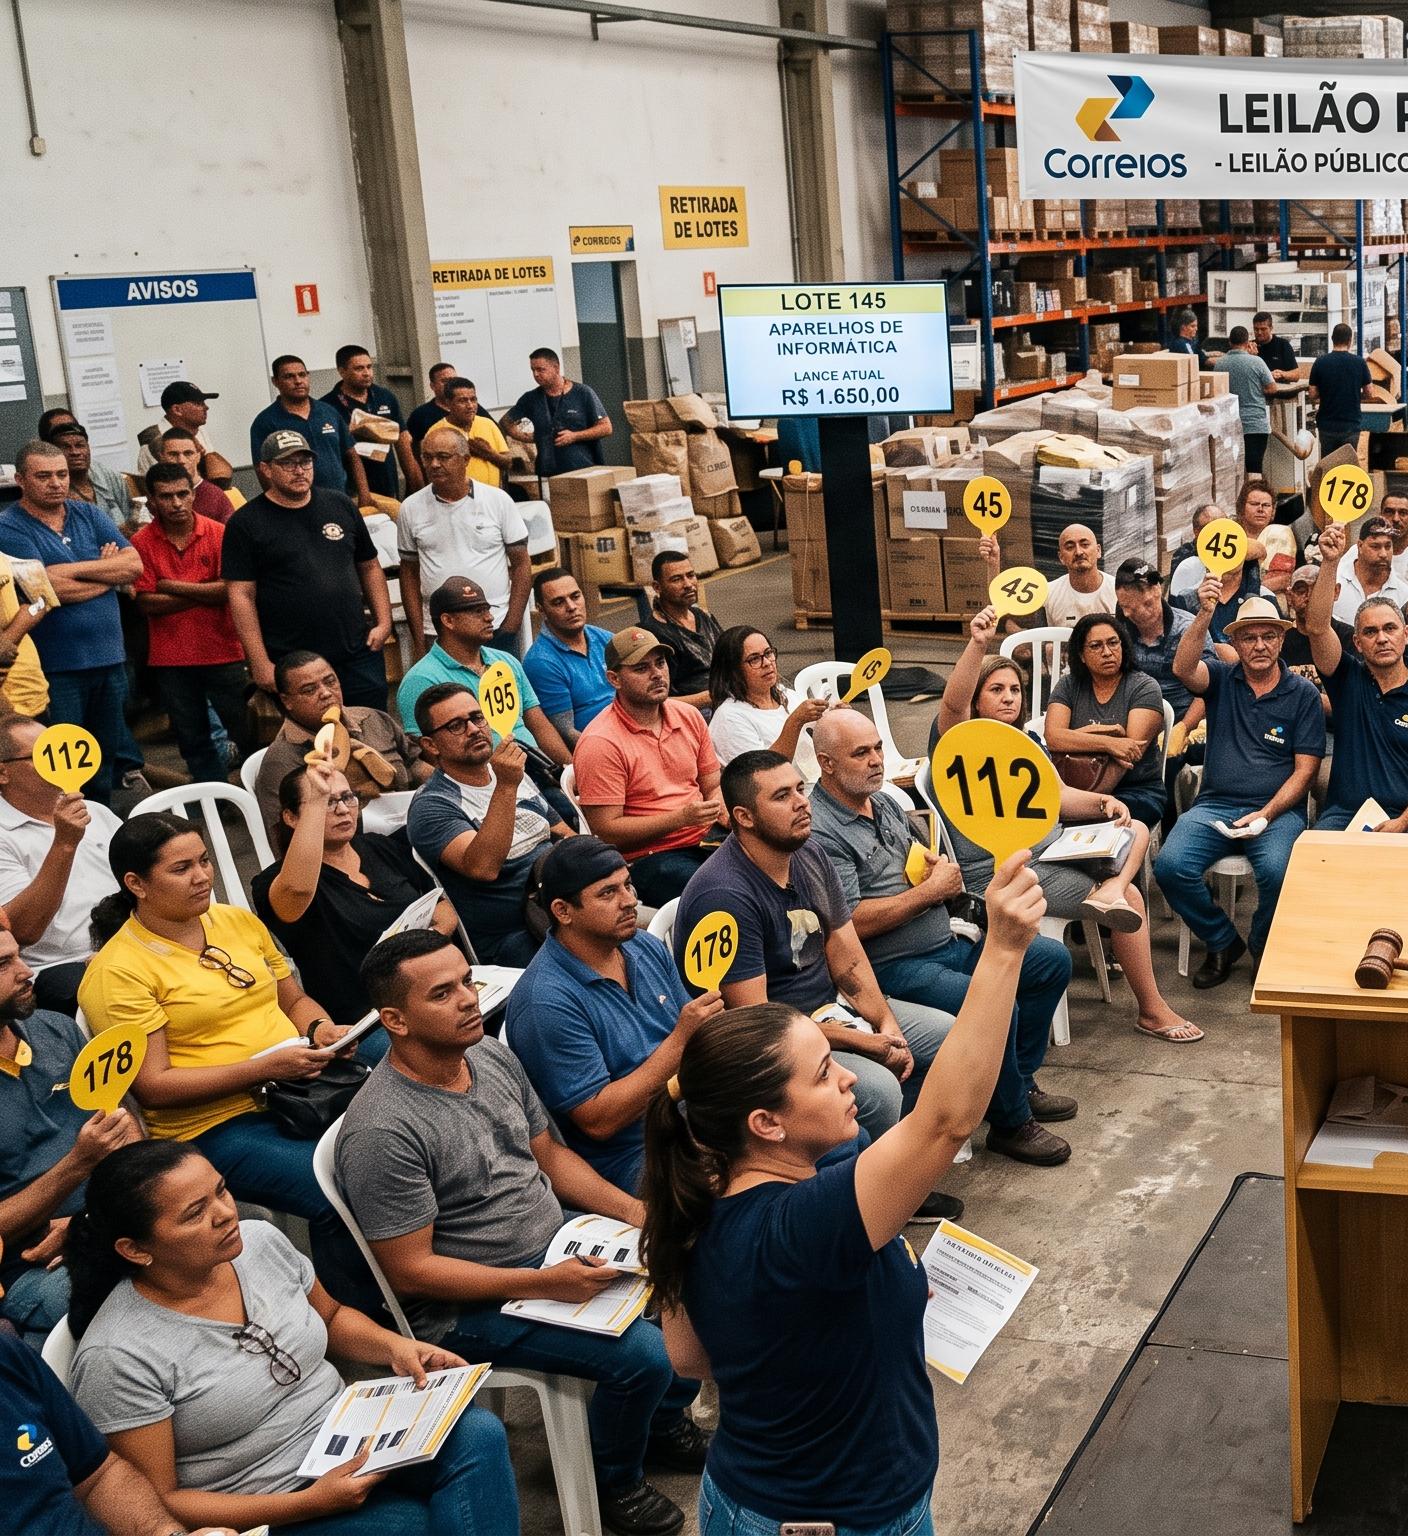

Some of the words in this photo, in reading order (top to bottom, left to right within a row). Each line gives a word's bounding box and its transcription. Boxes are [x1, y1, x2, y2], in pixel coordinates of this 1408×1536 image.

[1218, 81, 1380, 134] LEILÃO
[1044, 148, 1188, 179] Correios
[1228, 148, 1308, 173] LEILÃO
[670, 196, 738, 214] RETIRADA
[674, 221, 692, 238] DE
[696, 220, 738, 238] LOTES
[432, 269, 491, 283] RETIRADA
[495, 268, 509, 280] DE
[512, 266, 546, 279] LOTES
[127, 279, 199, 300] AVISOS
[781, 293, 841, 310] LOTE
[849, 291, 886, 309] 145
[769, 321, 875, 336] APARELHOS
[880, 320, 903, 333] DE
[777, 338, 898, 355] INFORMÁTICA
[794, 371, 839, 382] LANCE
[842, 370, 885, 381] ATUAL
[782, 388, 809, 406] R$
[816, 386, 900, 406] 1.650,00
[972, 491, 1003, 518] 45
[1326, 476, 1369, 510] 178
[1205, 532, 1238, 560] 45
[1001, 577, 1040, 604] 45
[485, 683, 515, 717] 195
[42, 739, 93, 772] 112
[946, 754, 1048, 820] 112
[691, 924, 733, 973] 178
[84, 1040, 133, 1093] 178
